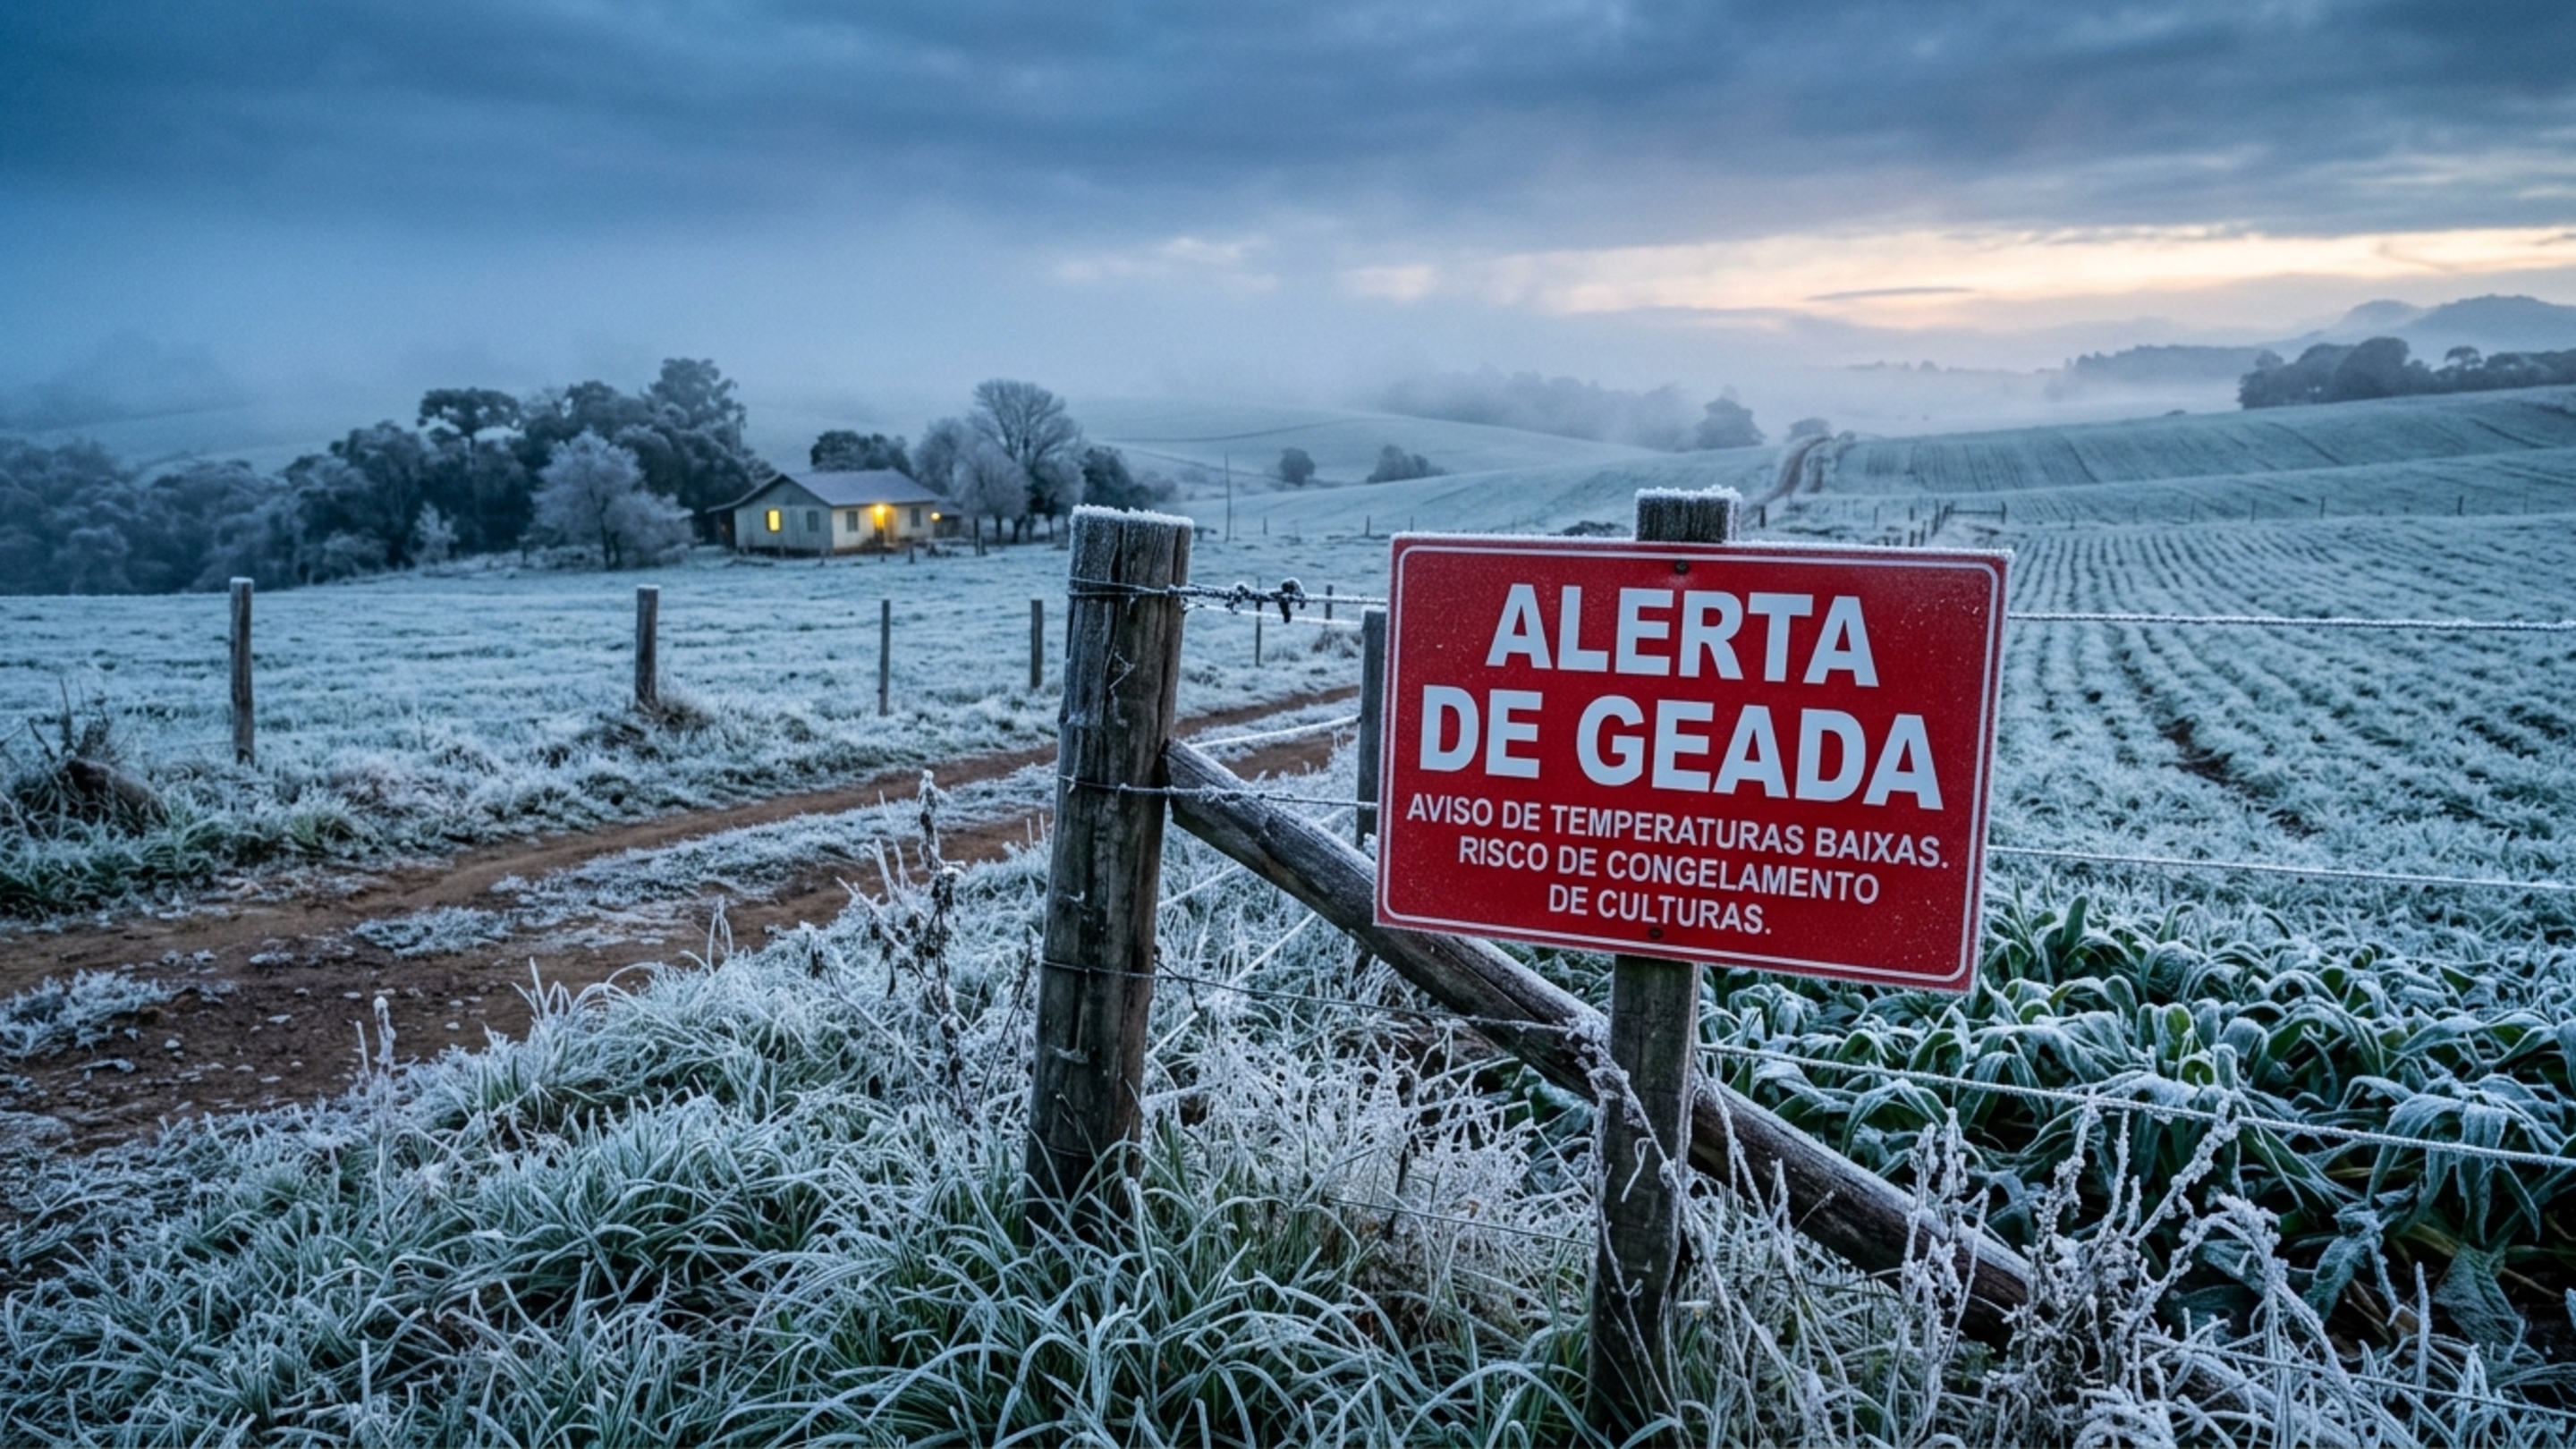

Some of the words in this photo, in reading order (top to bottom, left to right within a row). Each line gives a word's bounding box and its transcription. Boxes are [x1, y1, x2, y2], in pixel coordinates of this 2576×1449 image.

[1486, 583, 1879, 688] ALERTA
[1419, 684, 1544, 779] DE
[1575, 695, 1945, 810] GEADA
[1406, 793, 1494, 826] AVISO
[1502, 801, 1541, 831] DE
[1550, 805, 1805, 856] TEMPERATURAS
[1815, 827, 1950, 869] BAIXAS.
[1459, 835, 1549, 871] RISCO
[1557, 845, 1598, 877] DE
[1606, 851, 1879, 905] CONGELAMENTO
[1548, 884, 1589, 916] DE
[1597, 889, 1773, 936] CULTURAS.
